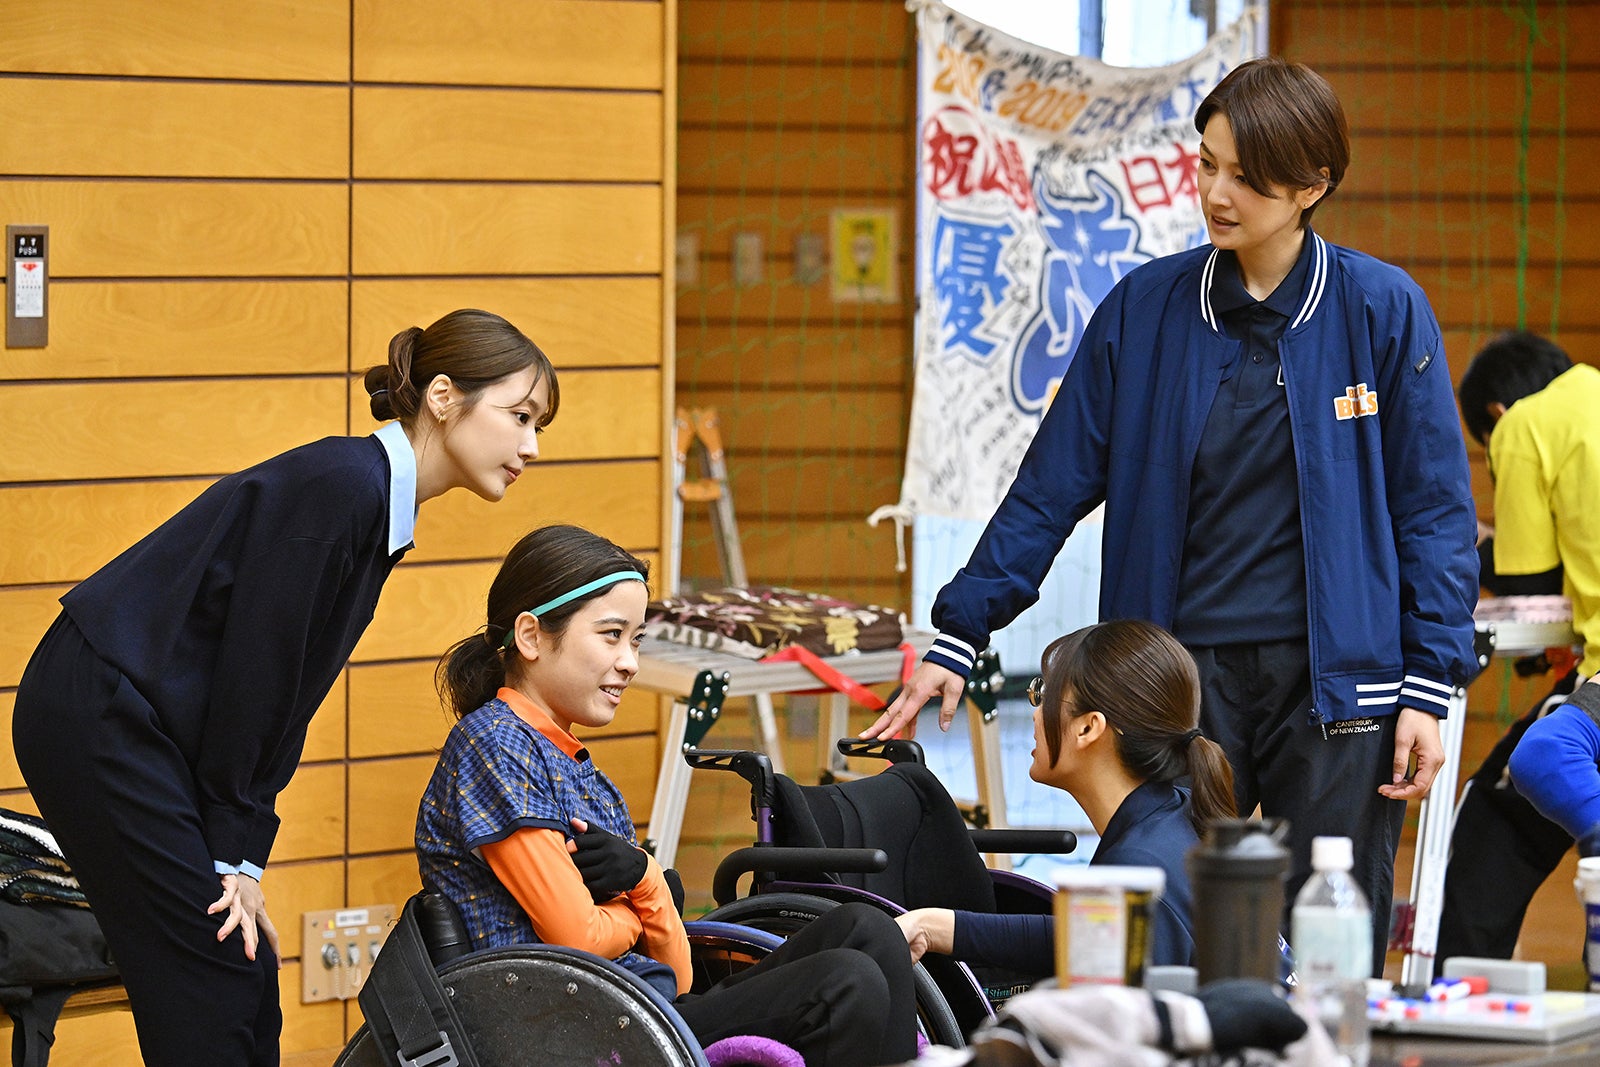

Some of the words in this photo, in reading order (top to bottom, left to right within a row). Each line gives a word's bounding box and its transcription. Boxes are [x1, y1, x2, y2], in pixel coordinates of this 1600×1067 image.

[18, 247, 37, 256] PUSH
[1335, 719, 1373, 728] CANTERBURY
[1354, 724, 1380, 733] ZEALAND
